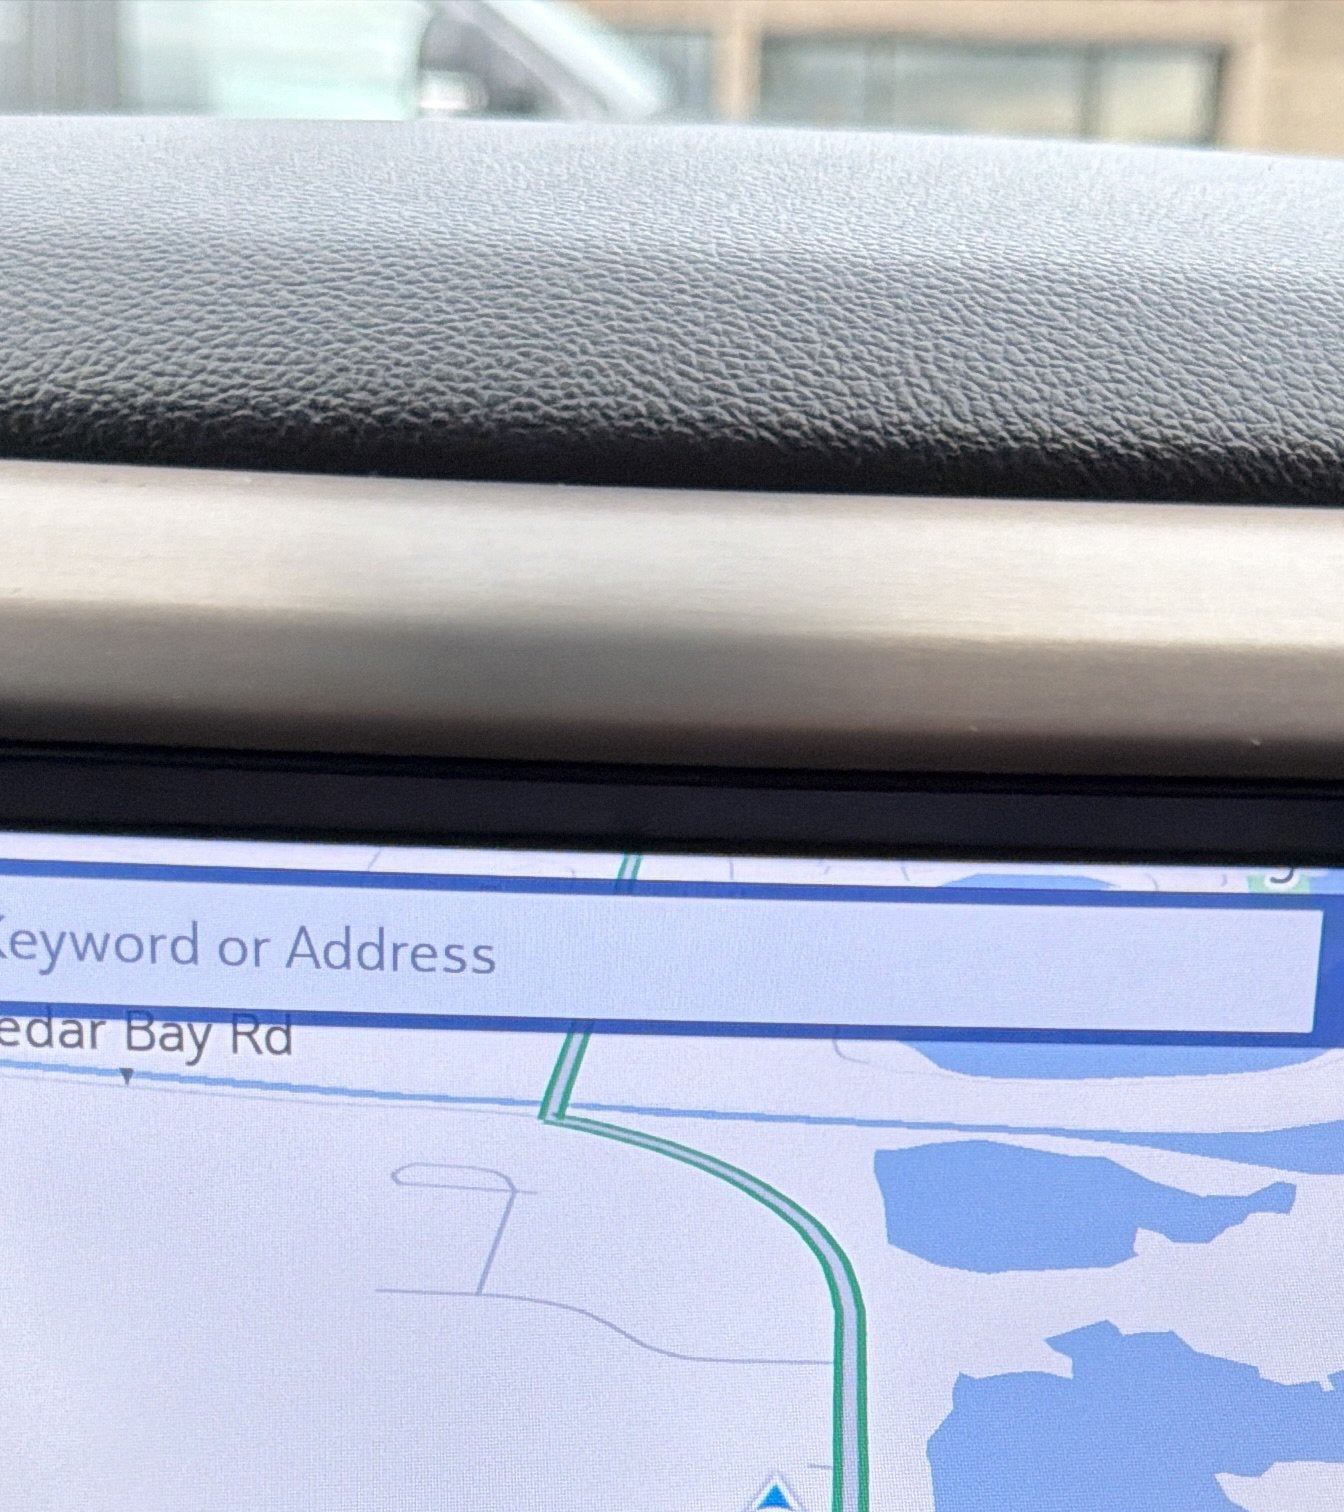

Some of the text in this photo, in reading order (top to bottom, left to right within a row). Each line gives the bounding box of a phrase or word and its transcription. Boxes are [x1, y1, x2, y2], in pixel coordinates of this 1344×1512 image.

[218, 937, 273, 969] or
[286, 926, 496, 975] Address
[126, 1010, 212, 1066] Bay
[231, 1013, 293, 1056] Rd
